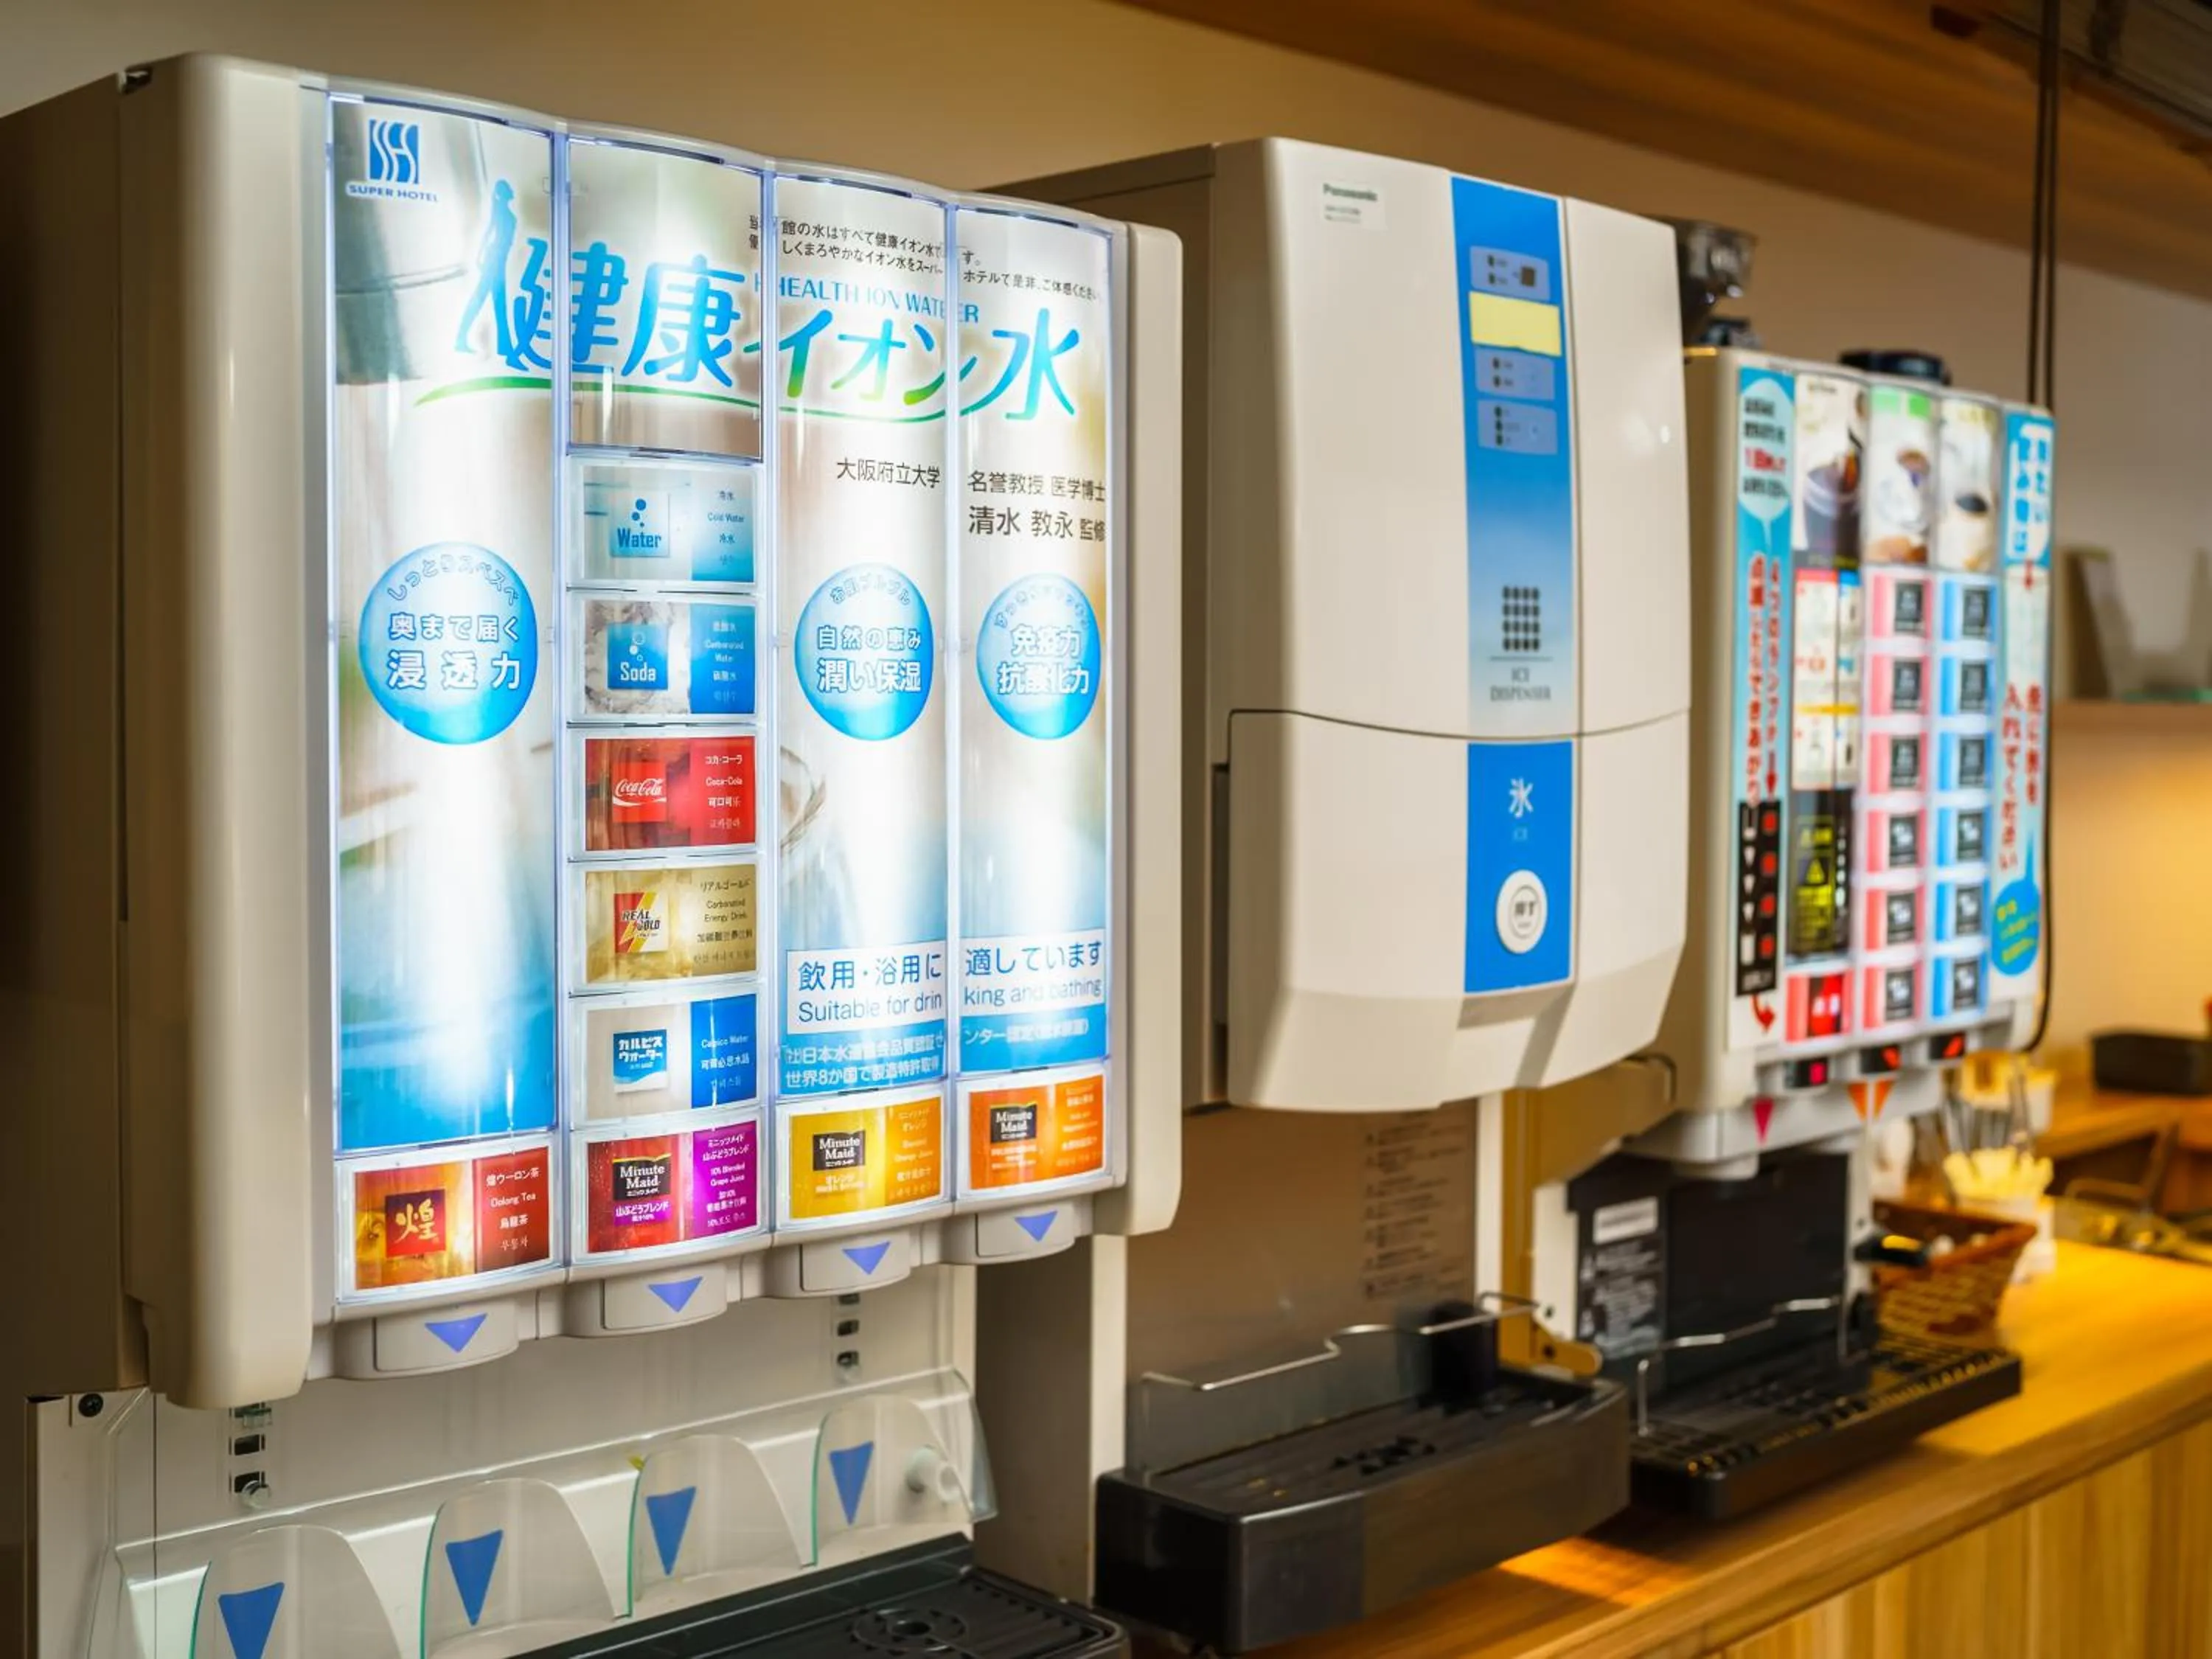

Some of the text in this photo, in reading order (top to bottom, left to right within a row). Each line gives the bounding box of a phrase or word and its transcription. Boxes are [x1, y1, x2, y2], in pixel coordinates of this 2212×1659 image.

[348, 184, 439, 203] SUPER HOTEL
[509, 237, 1079, 420] 健康イオン水
[837, 457, 941, 489] 大阪府立大学
[967, 470, 1105, 502] 名誉教授 医学博士
[968, 505, 1021, 536] 清水
[1031, 509, 1073, 540] 教永
[617, 528, 662, 549] Water
[388, 612, 519, 642] 奥まで届く
[816, 625, 922, 651] 自然の恵み
[1011, 623, 1081, 658] 免疫力
[386, 649, 521, 690] 浸透力
[620, 662, 656, 682] Soda
[816, 658, 922, 693] 潤い保湿
[1509, 777, 1534, 818] 氷
[622, 909, 653, 922] REAL
[965, 940, 1102, 976] 適しています
[798, 953, 942, 992] 飲用・浴用に
[799, 997, 881, 1023] Suitable
[887, 995, 910, 1015] for
[701, 1037, 728, 1048] Caico
[1001, 1120, 1029, 1133] Maid
[819, 1136, 861, 1150] Minute
[825, 1147, 855, 1161] Maid
[620, 1164, 665, 1180] Minute
[626, 1173, 661, 1189] Maid
[521, 1192, 537, 1203] Tea
